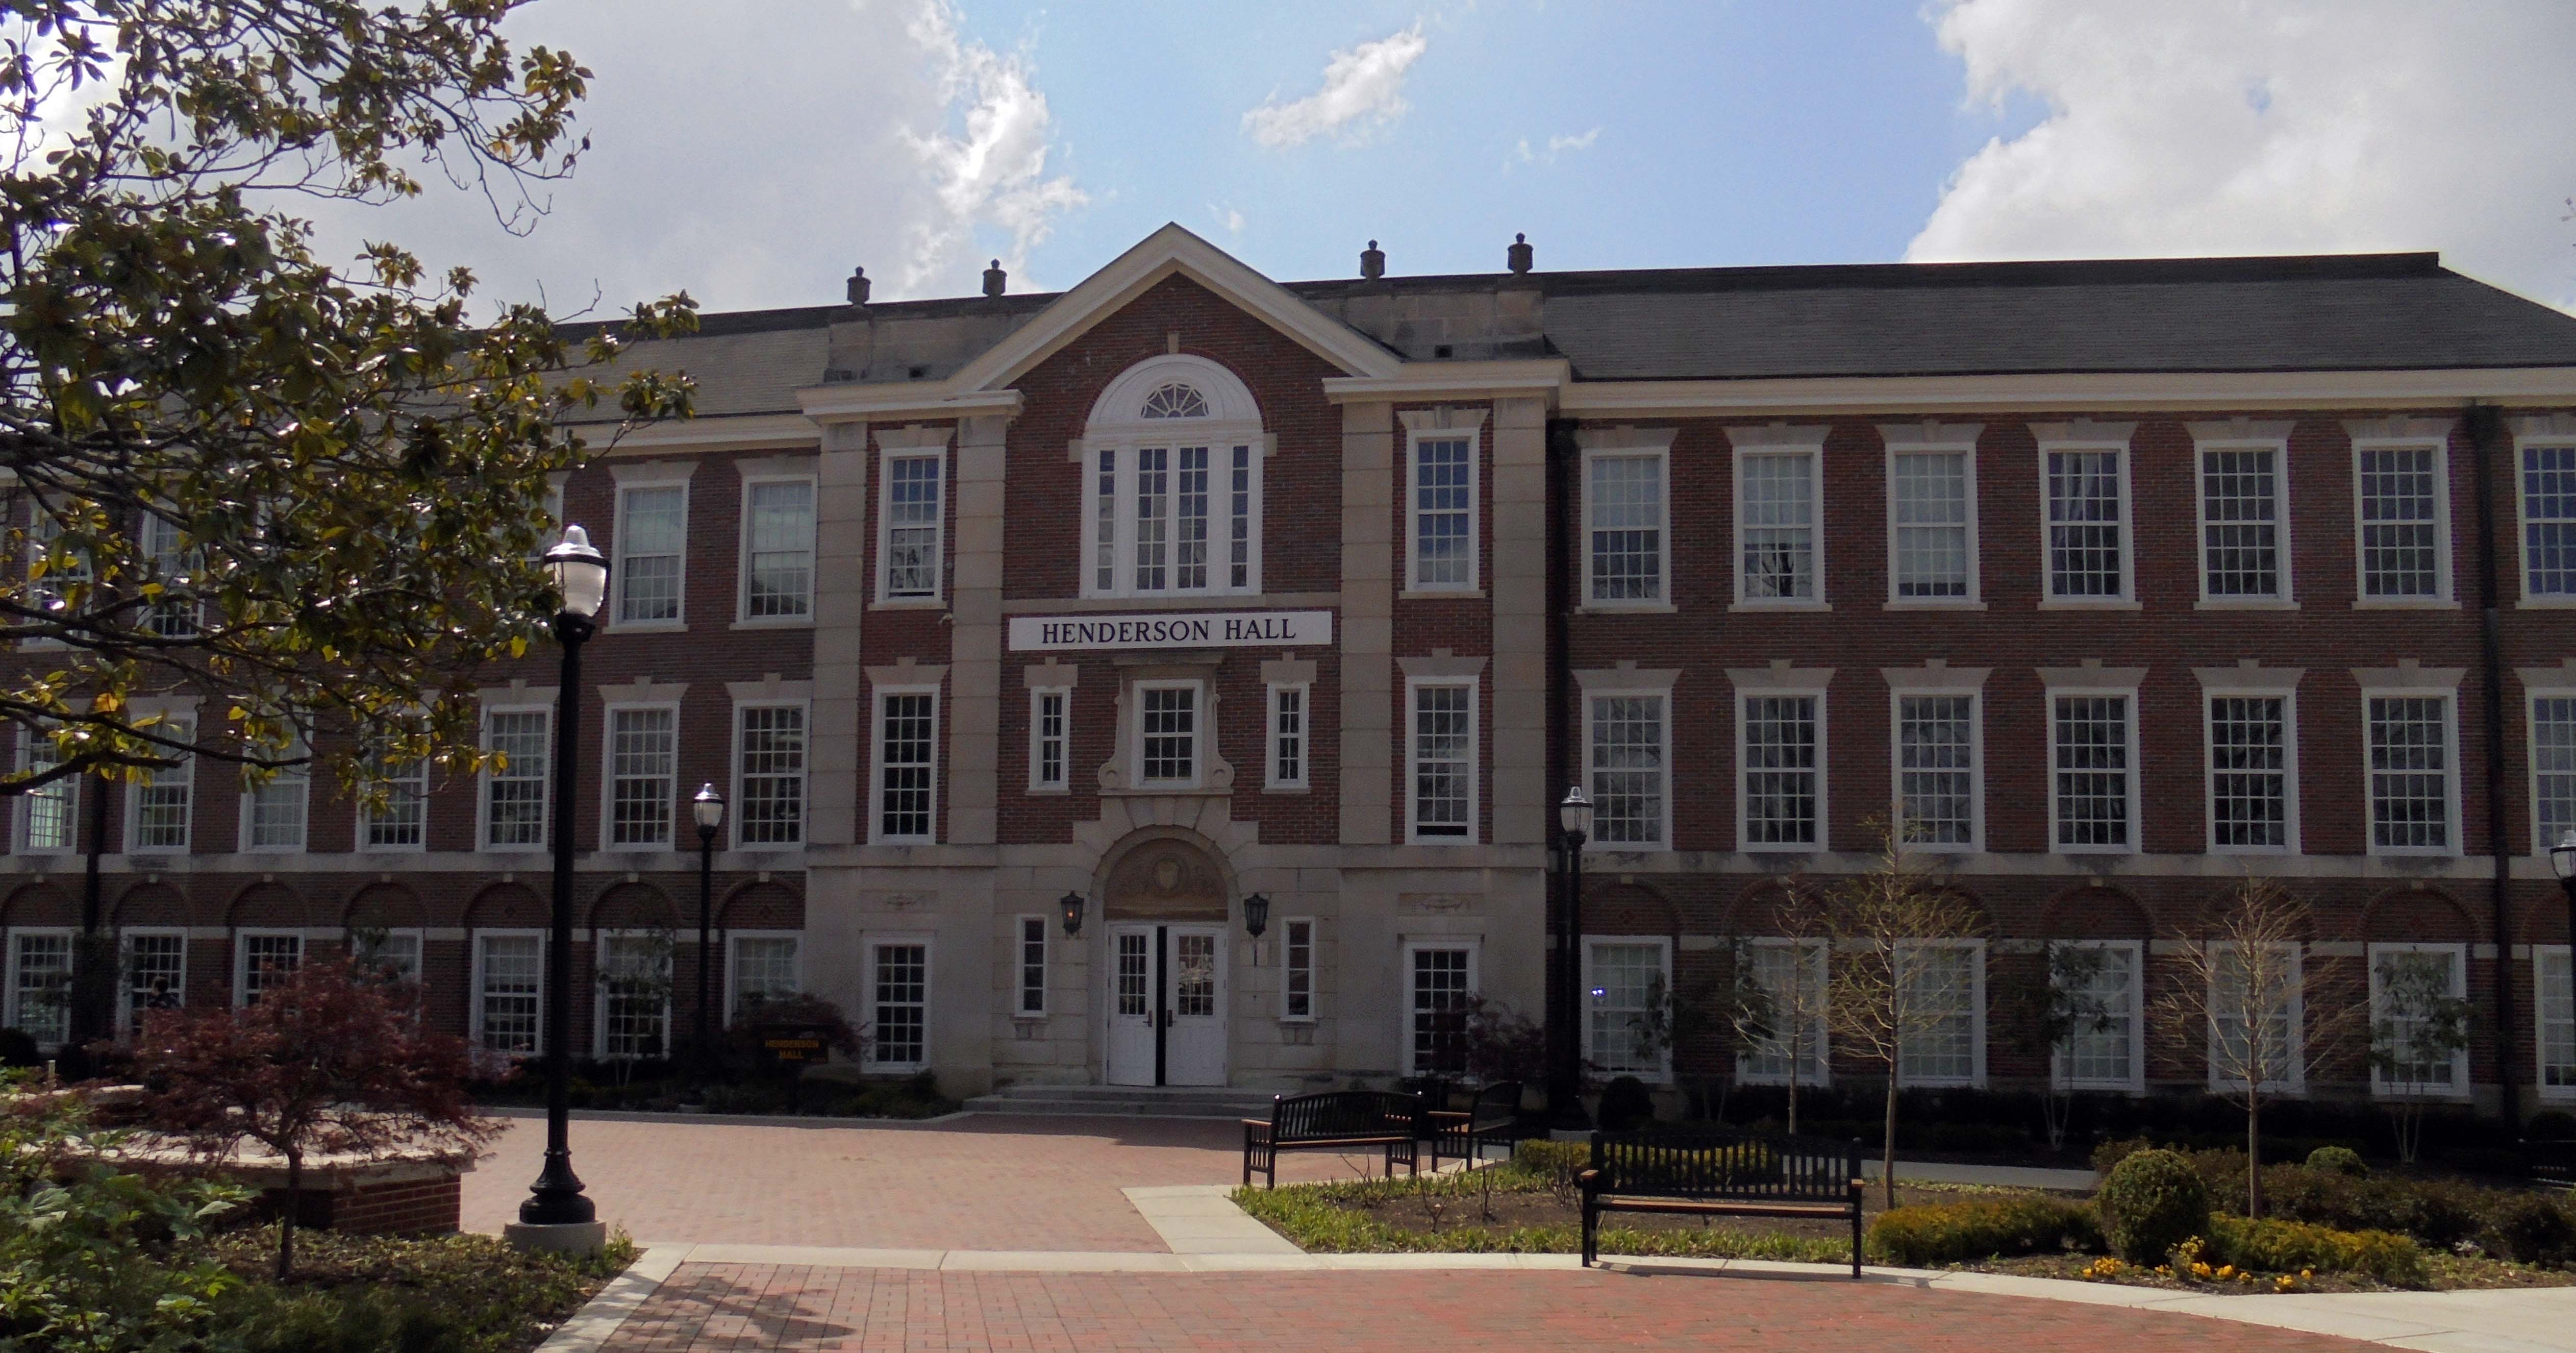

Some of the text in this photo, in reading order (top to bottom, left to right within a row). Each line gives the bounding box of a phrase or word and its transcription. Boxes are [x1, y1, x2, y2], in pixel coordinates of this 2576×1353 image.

[1042, 619, 1296, 644] HENDERSON HALL
[765, 1039, 819, 1048] HENDERSON
[779, 1049, 804, 1059] HALL
